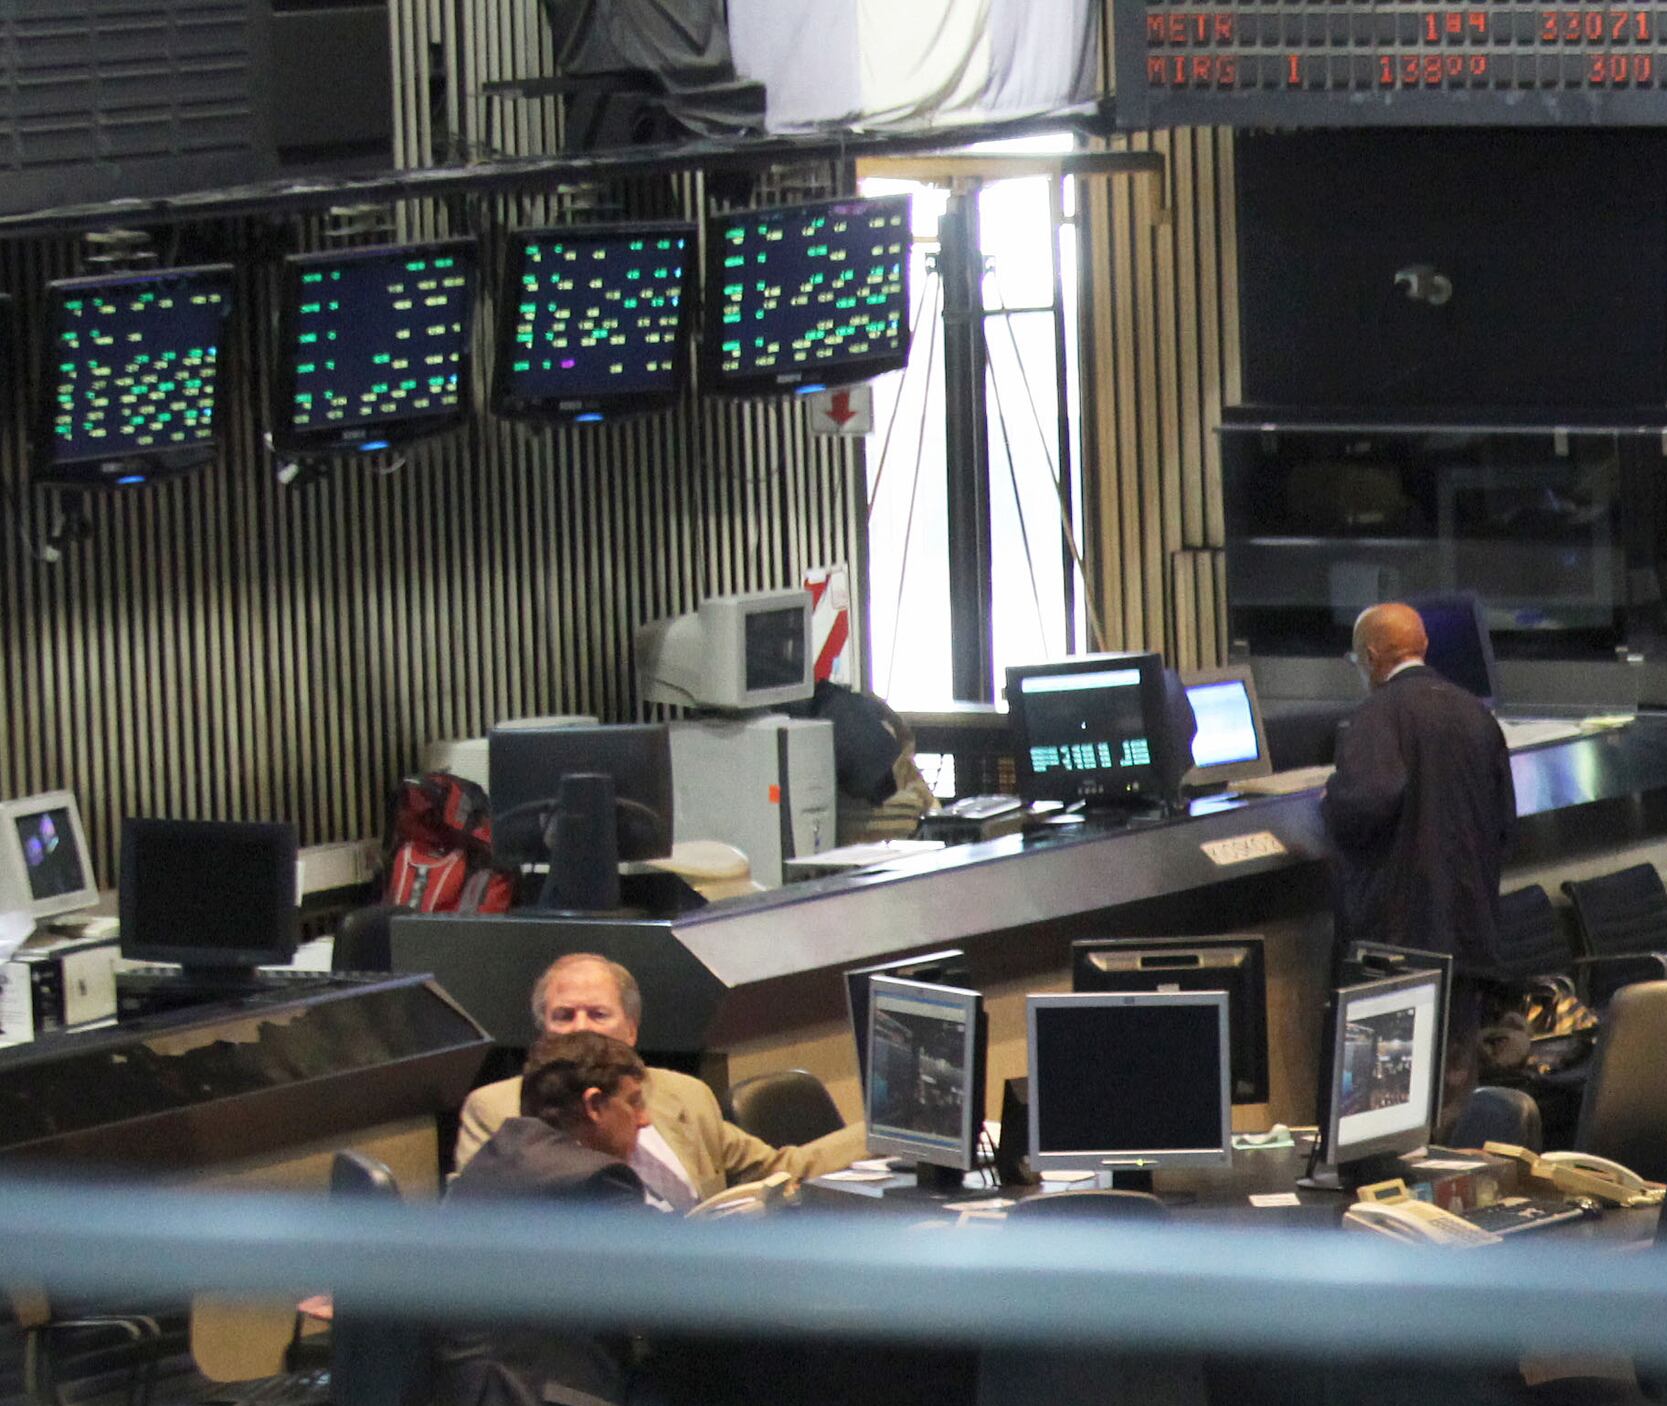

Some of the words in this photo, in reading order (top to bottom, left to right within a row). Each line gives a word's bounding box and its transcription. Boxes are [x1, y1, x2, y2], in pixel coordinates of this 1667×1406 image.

[1148, 14, 1233, 42] METR
[1544, 12, 1649, 41] 33071
[1148, 56, 1235, 84] MIRG
[1591, 55, 1653, 84] 300
